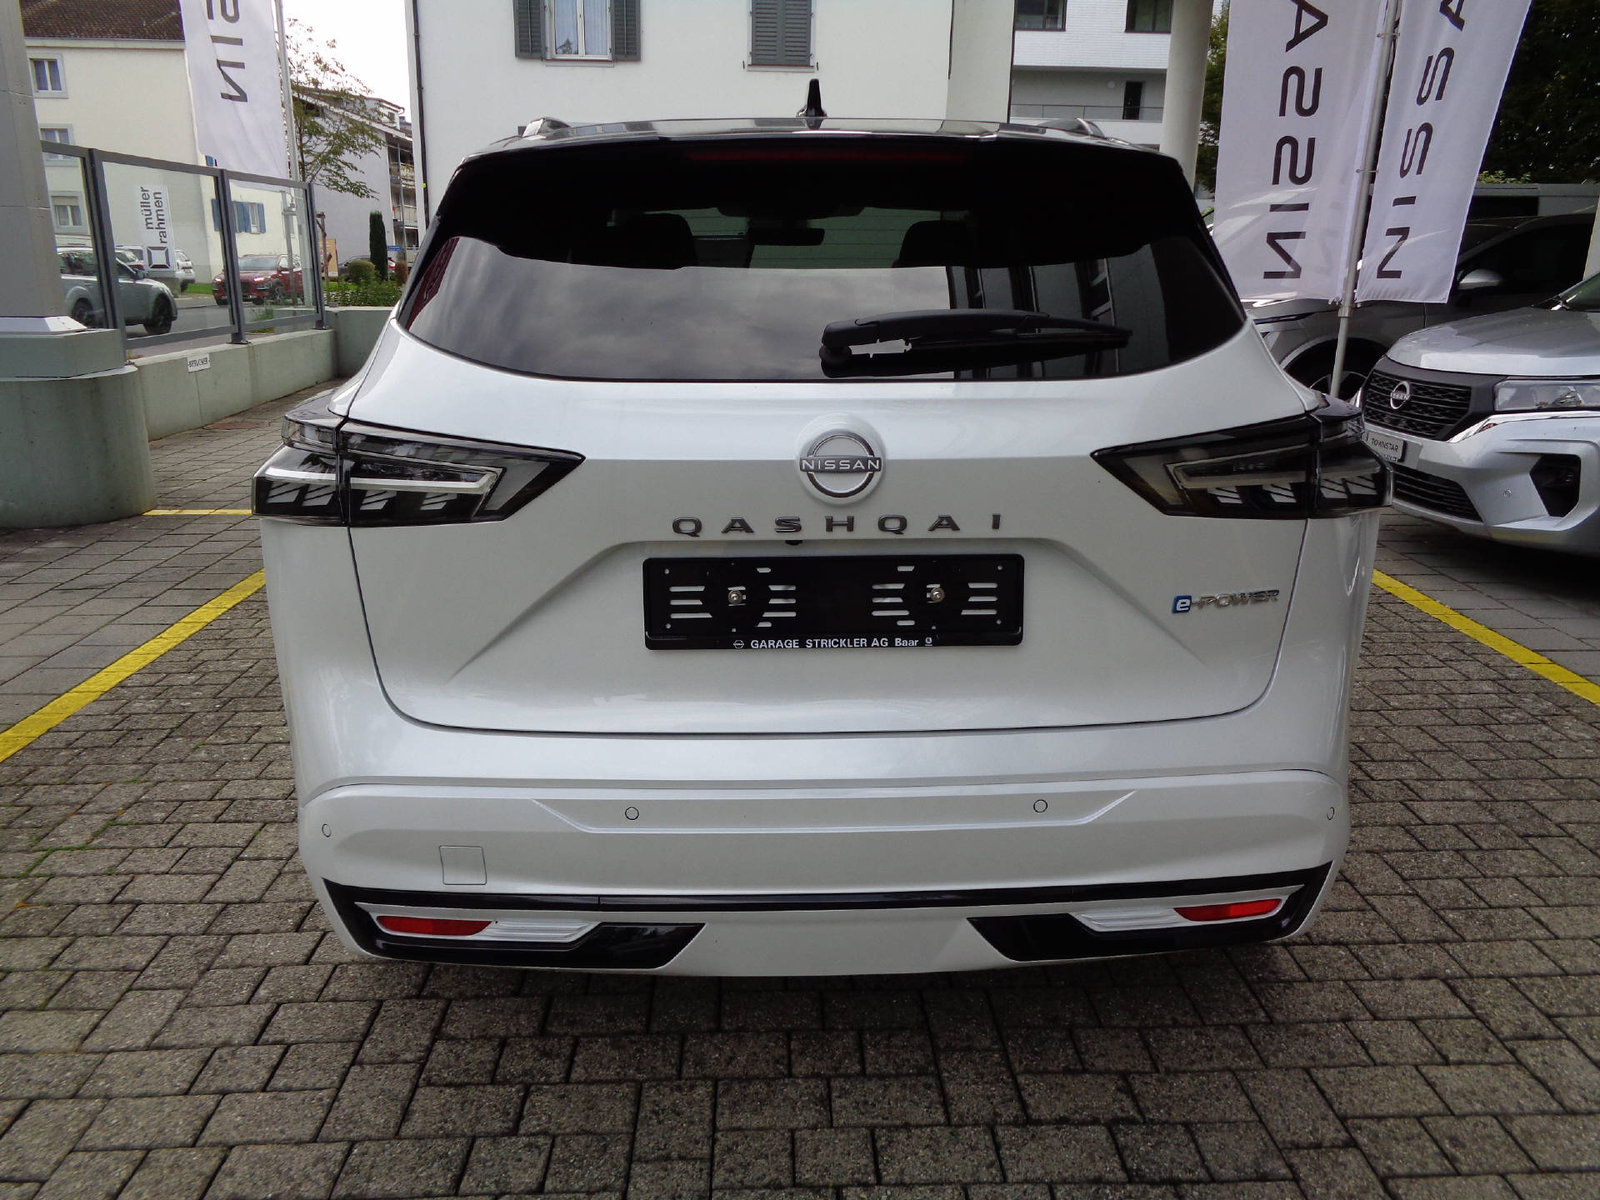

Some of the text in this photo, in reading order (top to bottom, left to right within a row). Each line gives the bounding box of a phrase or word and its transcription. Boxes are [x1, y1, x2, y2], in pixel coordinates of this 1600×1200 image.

[140, 186, 154, 230] müller
[153, 191, 168, 244] rahmen
[1371, 437, 1399, 452] TOWNSTAR
[801, 459, 880, 470] NISSAN
[672, 514, 1001, 537] QASHQAI
[750, 637, 919, 649] GARAGE STRICKLER AG Baar
